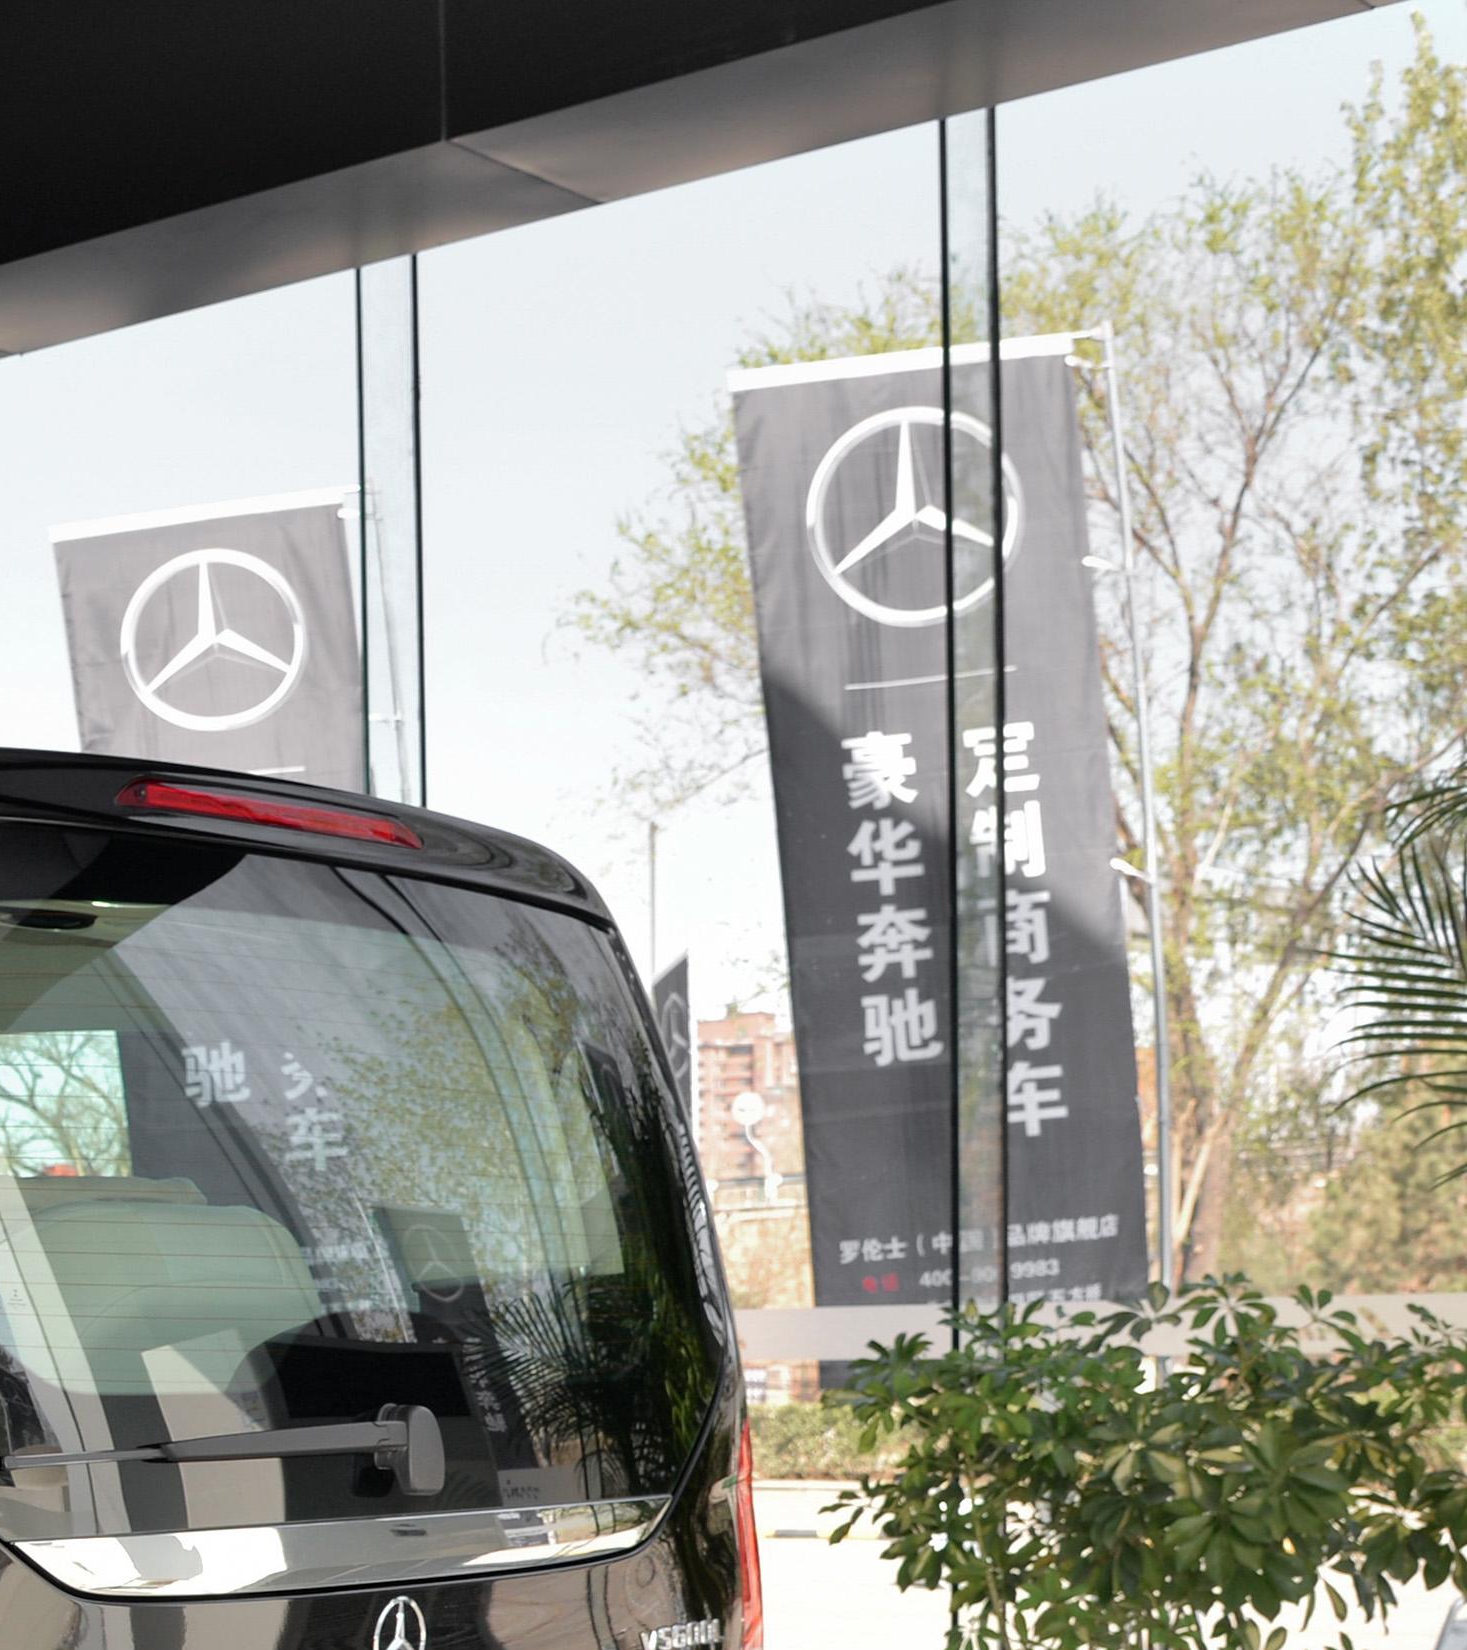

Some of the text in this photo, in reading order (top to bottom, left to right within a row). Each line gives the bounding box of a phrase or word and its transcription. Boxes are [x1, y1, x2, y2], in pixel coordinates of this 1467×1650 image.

[841, 731, 944, 1067] 豪华奔驰
[963, 721, 1069, 1137] 定制商务车
